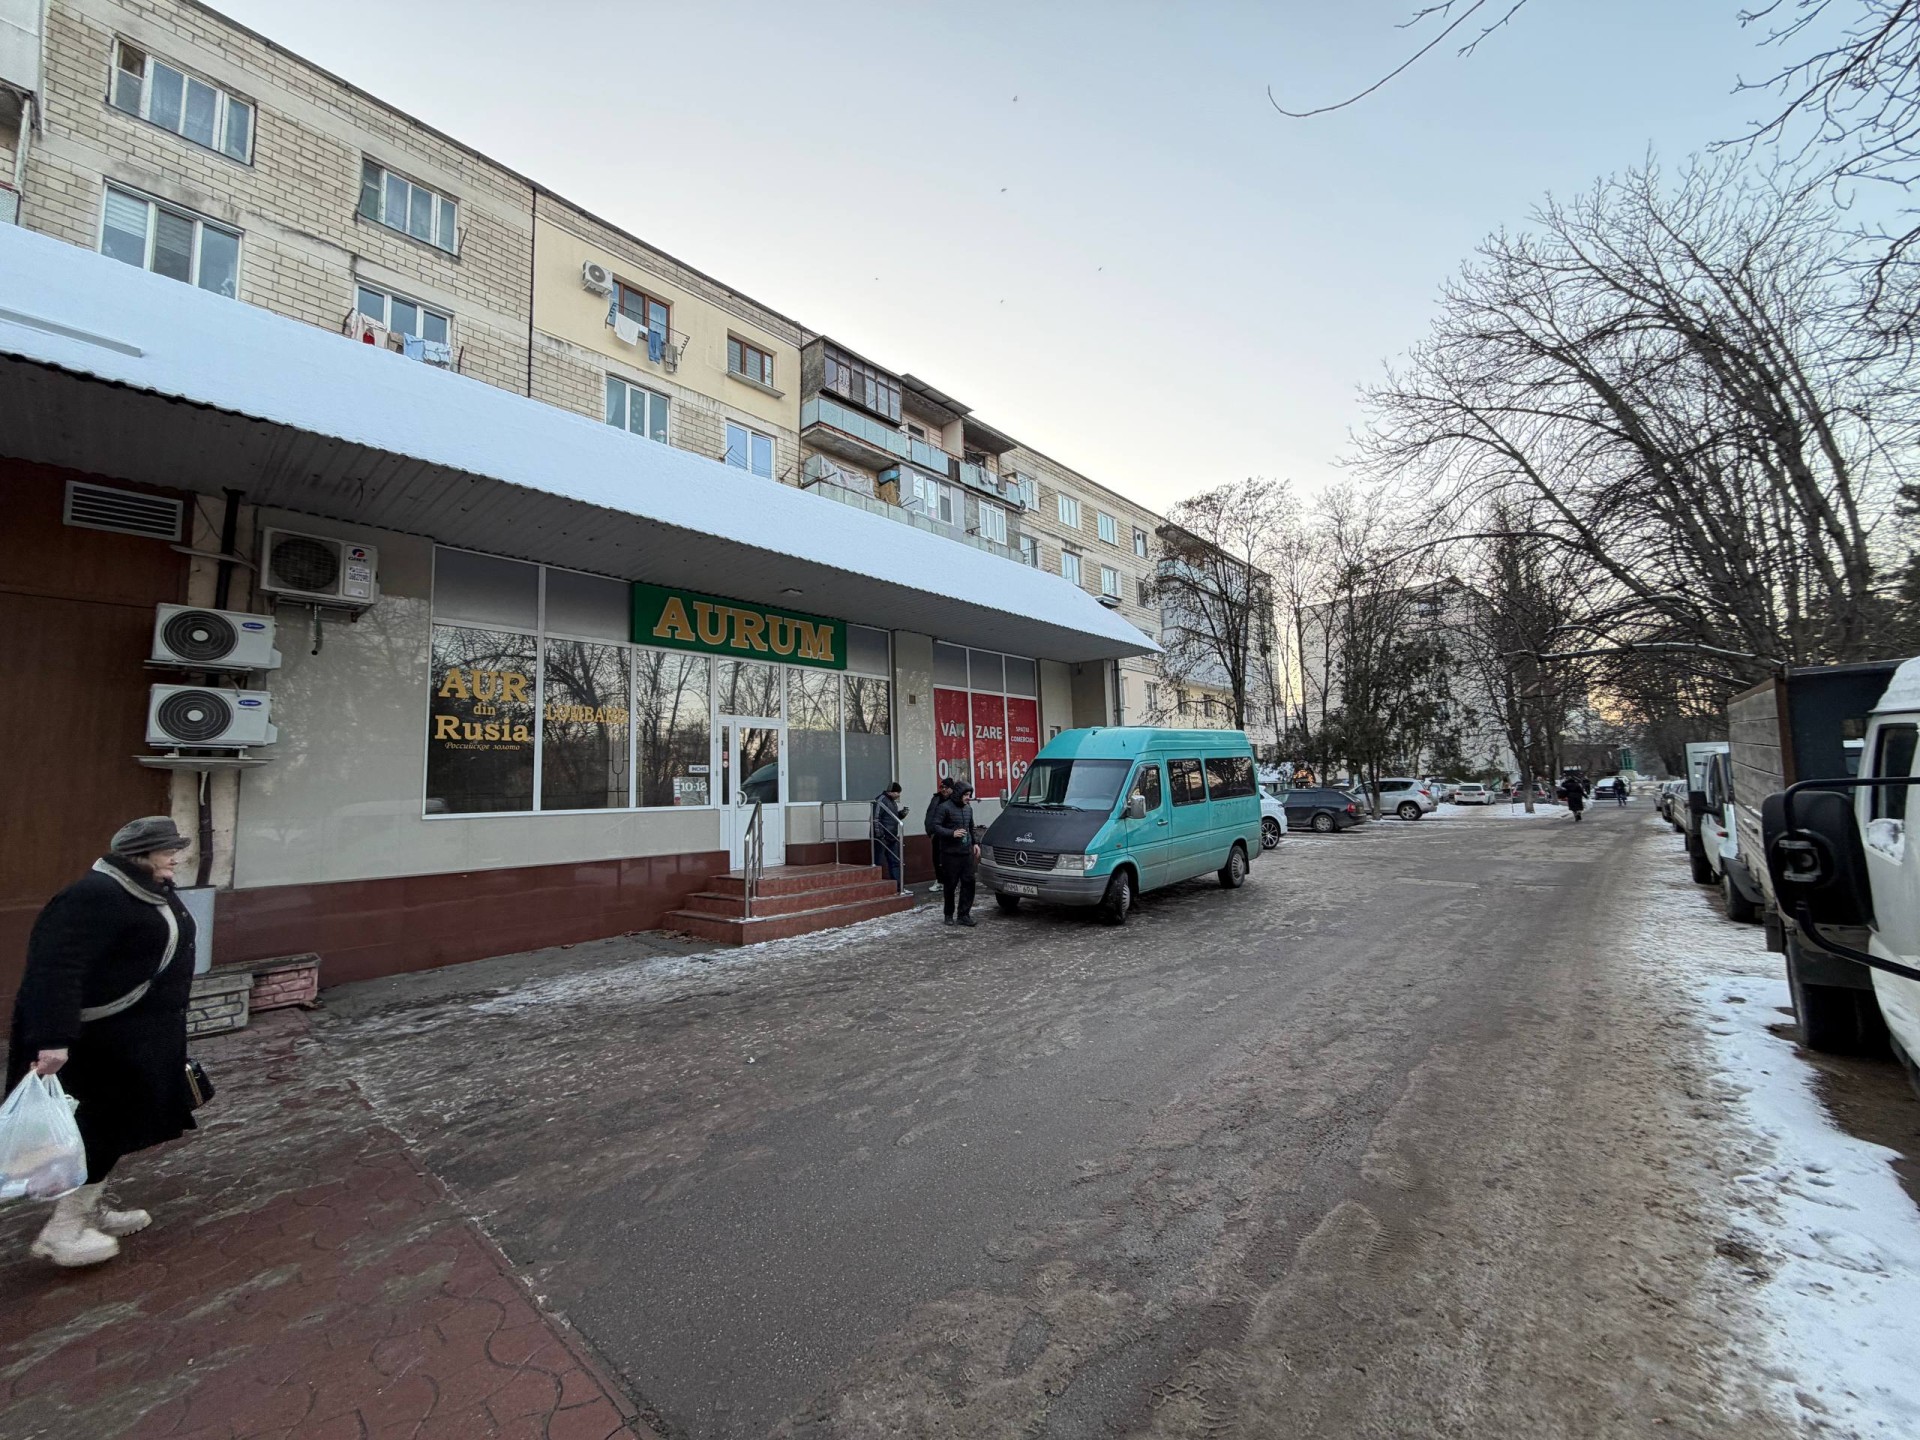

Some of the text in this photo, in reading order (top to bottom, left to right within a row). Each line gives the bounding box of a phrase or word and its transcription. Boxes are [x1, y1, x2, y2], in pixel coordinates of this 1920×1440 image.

[653, 597, 834, 661] AURUM
[438, 667, 528, 702] AUR
[473, 703, 496, 716] din
[546, 703, 628, 724] LOMBARD
[434, 715, 529, 742] Rusia
[975, 725, 1003, 739] ZARE
[444, 741, 490, 751] Российское
[977, 760, 1003, 779] 111
